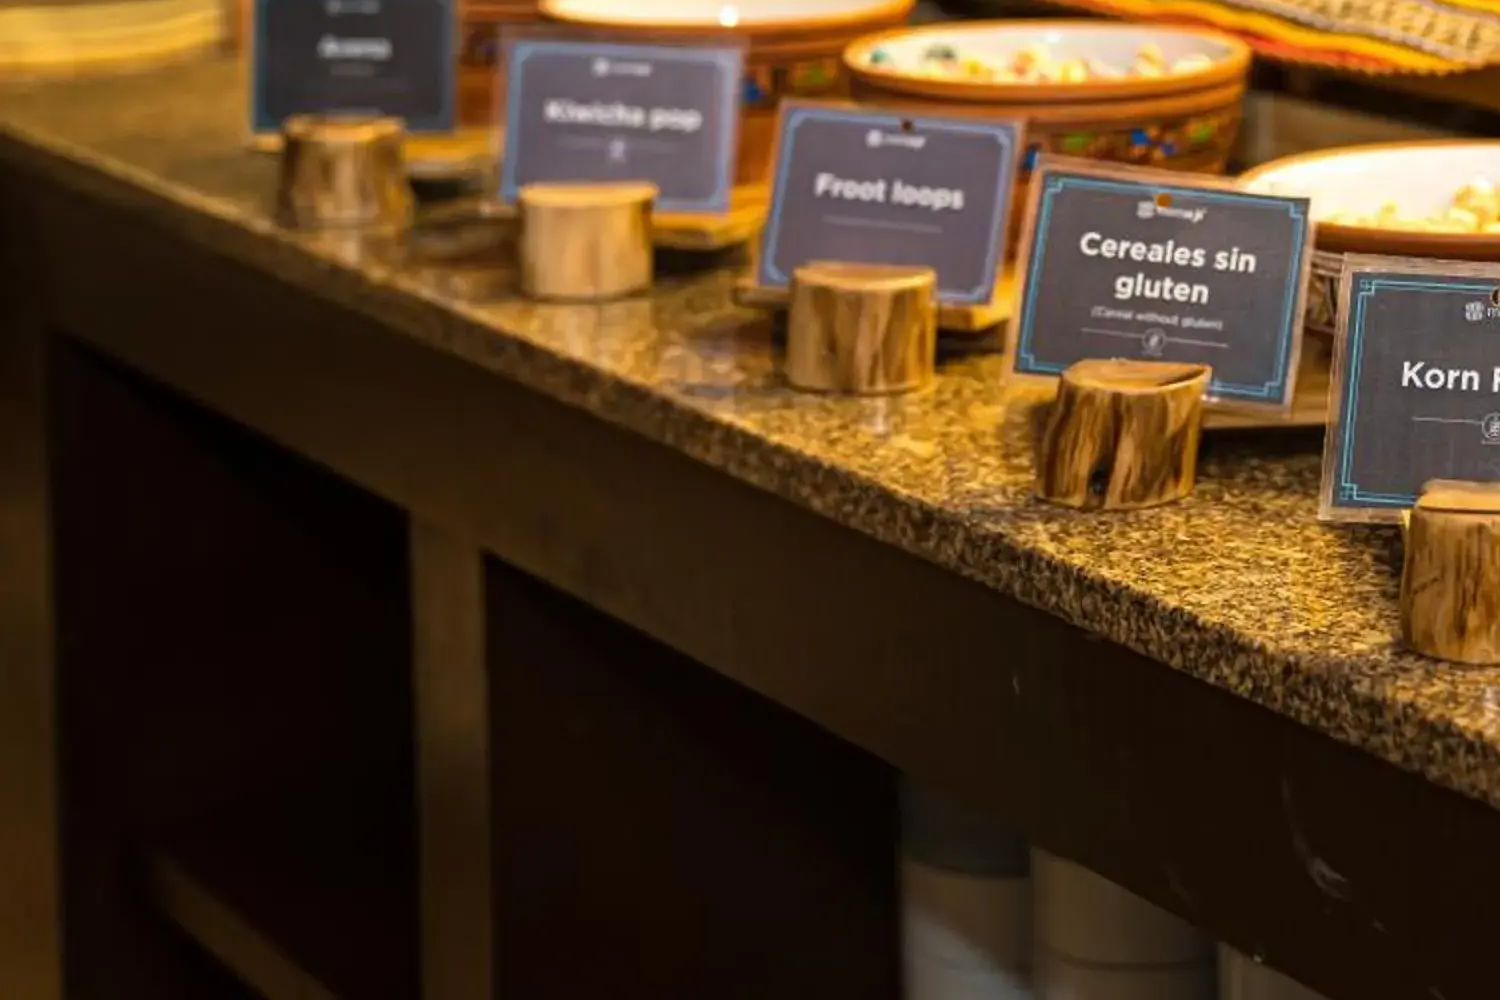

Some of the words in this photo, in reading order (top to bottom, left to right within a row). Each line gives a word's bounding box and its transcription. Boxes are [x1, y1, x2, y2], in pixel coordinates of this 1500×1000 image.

[815, 172, 885, 202] Froot
[891, 179, 964, 211] loops
[1080, 232, 1206, 267] Cereales
[1213, 247, 1256, 273] sin
[1114, 273, 1209, 304] gluten
[1401, 361, 1480, 391] Korn
